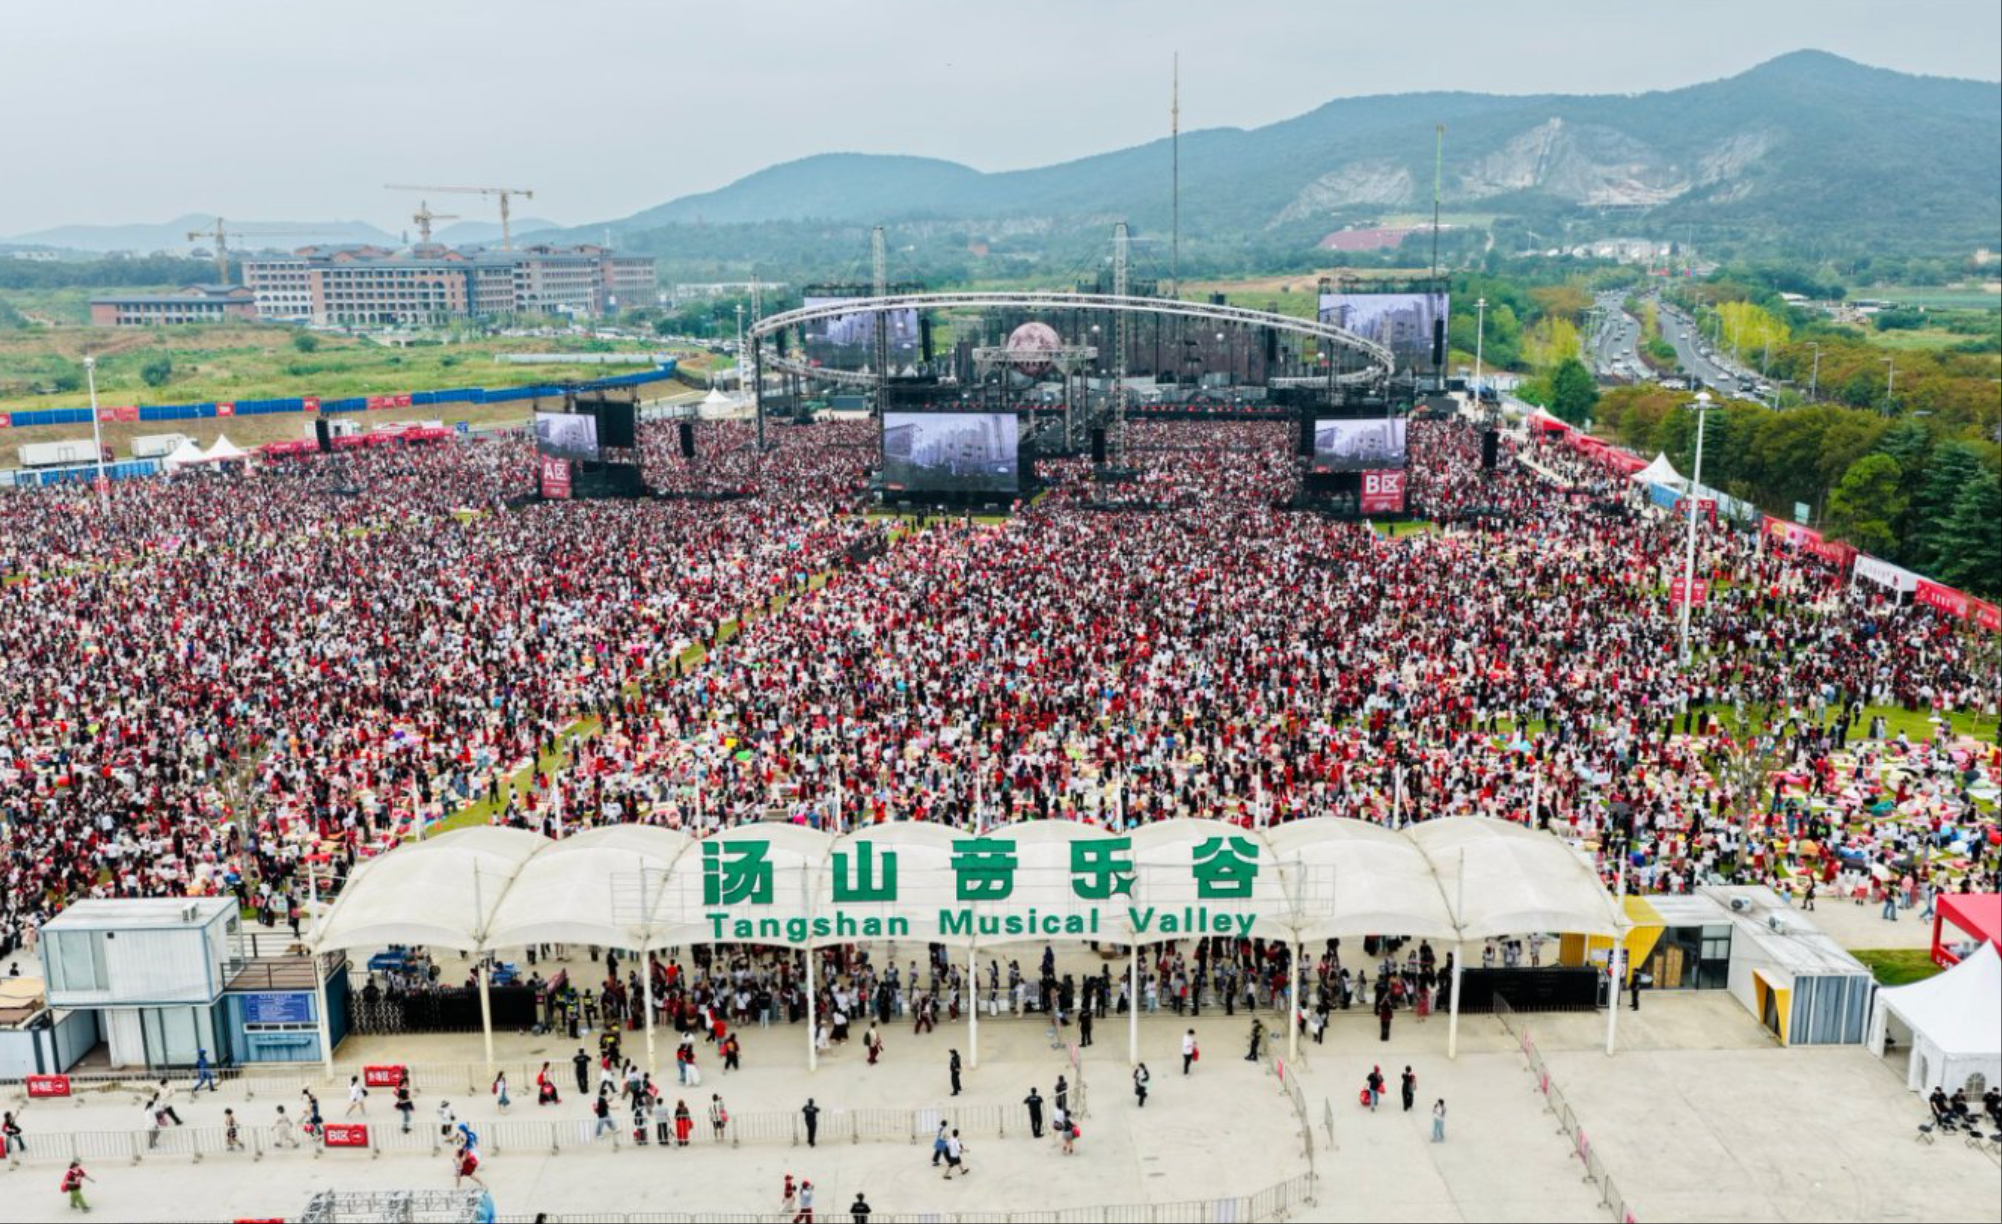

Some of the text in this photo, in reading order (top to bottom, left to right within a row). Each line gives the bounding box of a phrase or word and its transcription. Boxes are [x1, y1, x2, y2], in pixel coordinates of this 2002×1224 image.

[543, 462, 569, 480] A区
[1365, 474, 1400, 494] B区
[701, 836, 1259, 905] 汤山音乐谷
[705, 906, 1257, 942] Tangshan Musical Valley
[328, 1129, 351, 1142] B区
